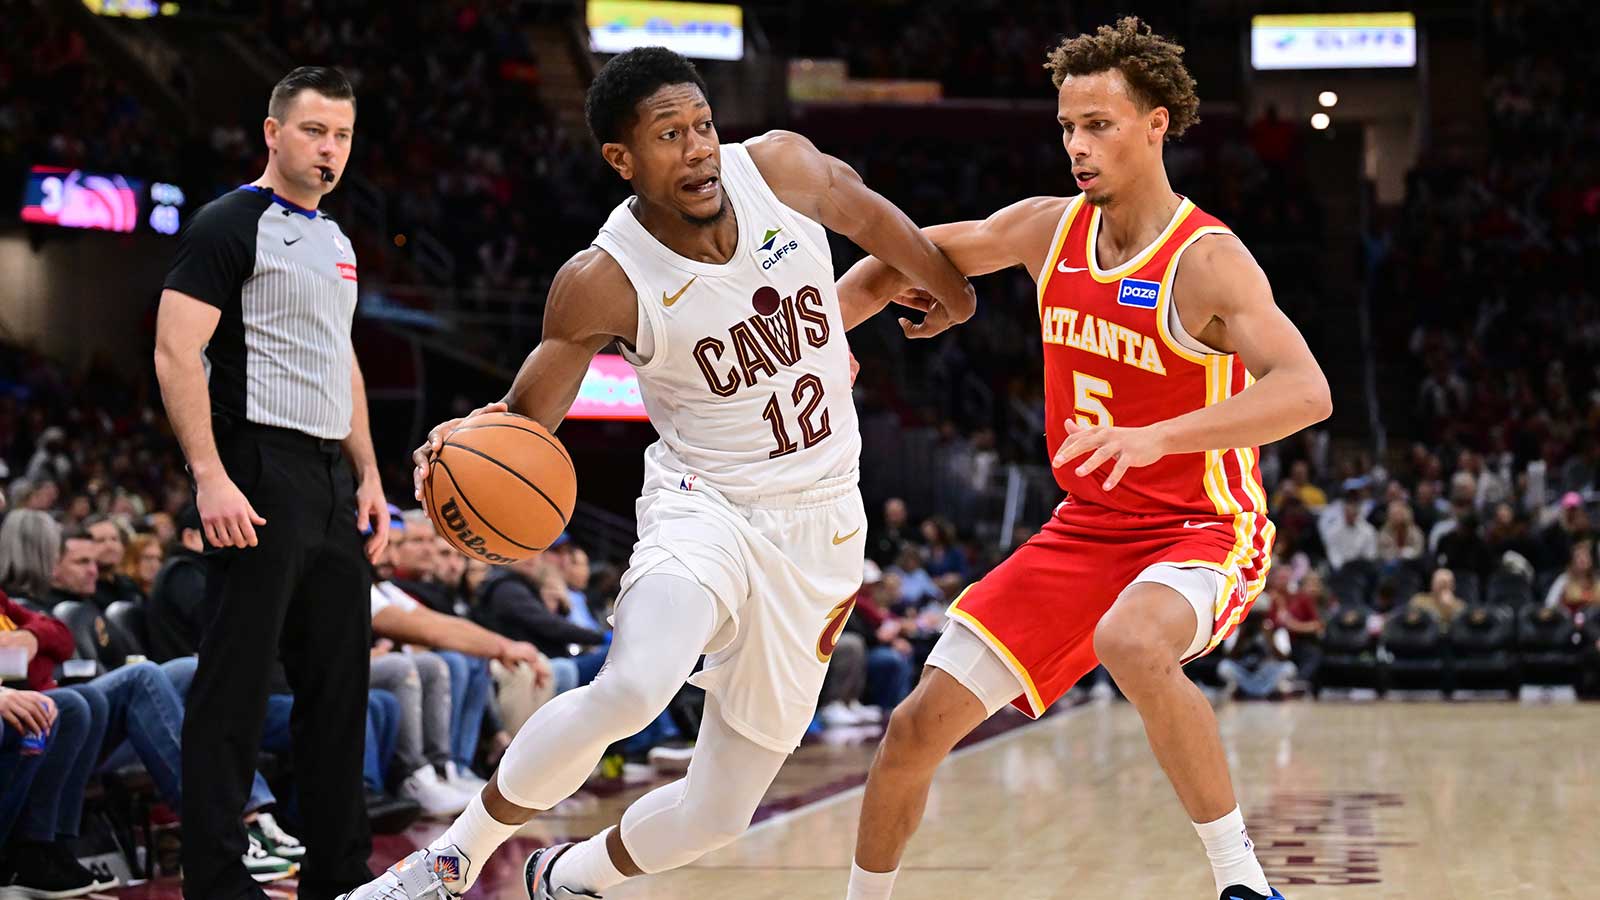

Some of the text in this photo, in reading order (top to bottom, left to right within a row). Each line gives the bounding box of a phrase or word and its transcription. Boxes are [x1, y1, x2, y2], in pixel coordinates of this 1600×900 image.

[762, 239, 799, 271] CLIFFS
[1122, 285, 1157, 299] paze
[692, 285, 830, 397] CAVS
[1042, 305, 1167, 377] ATLANTA
[762, 373, 832, 459] 12
[1072, 370, 1114, 431] 5
[440, 496, 519, 563] Wilson
